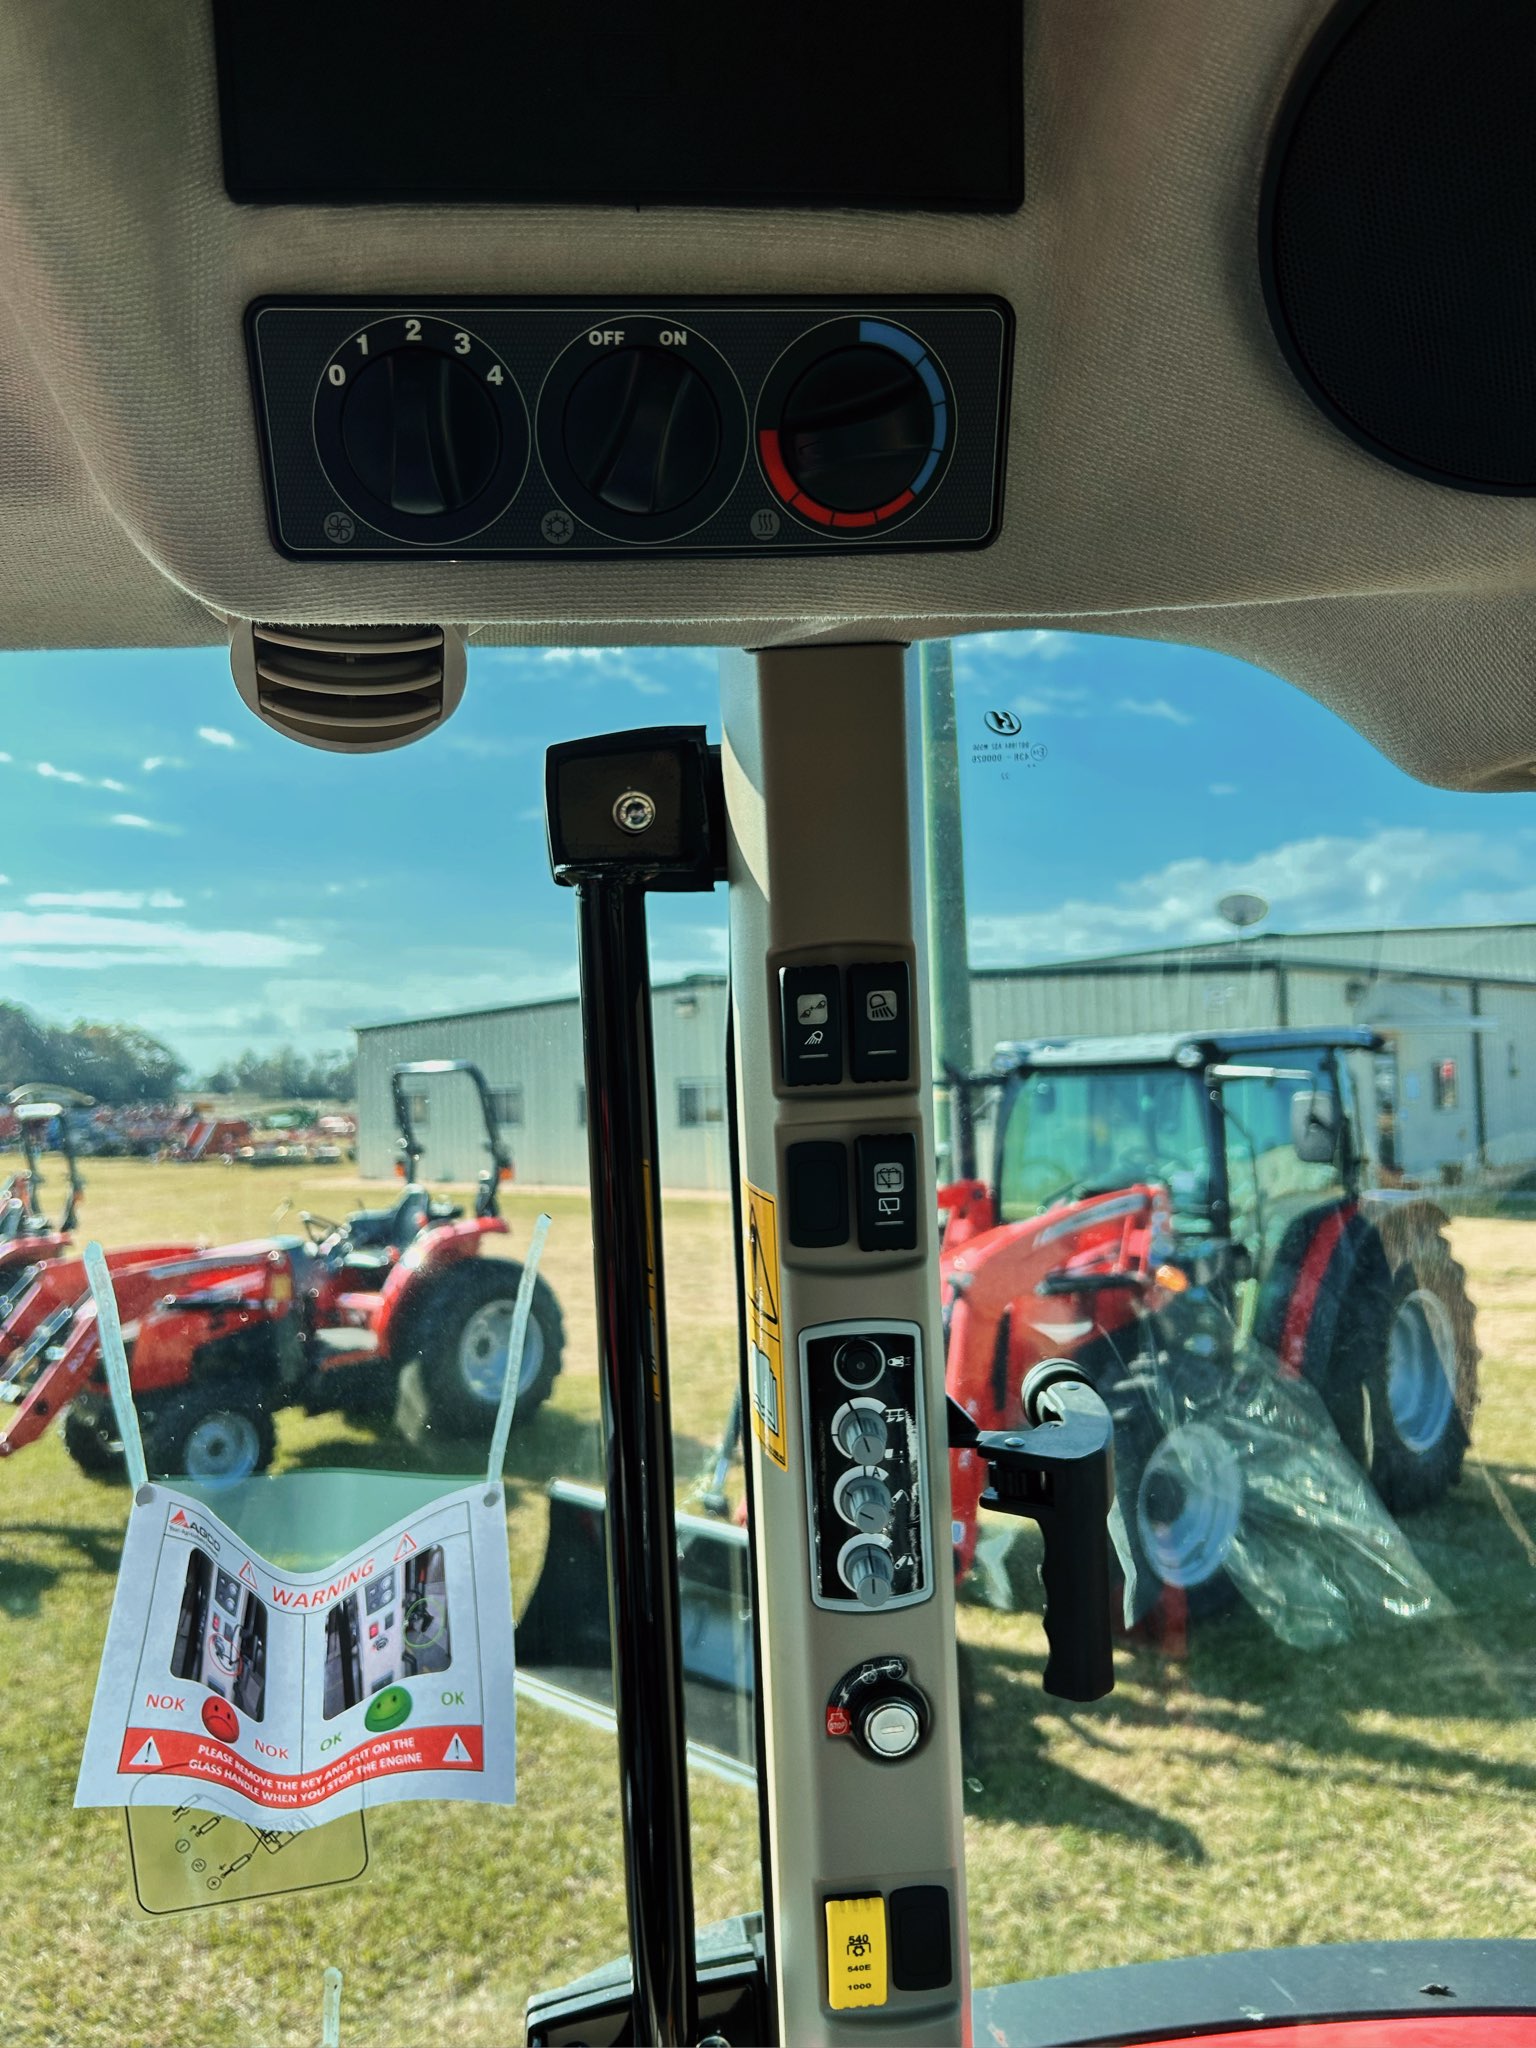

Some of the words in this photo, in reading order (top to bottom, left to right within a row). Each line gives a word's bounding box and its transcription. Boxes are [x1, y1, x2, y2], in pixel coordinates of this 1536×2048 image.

[588, 330, 625, 346] OFF
[659, 330, 688, 346] ON
[328, 364, 346, 386] 0
[356, 334, 369, 355] 1
[405, 319, 422, 341] 2
[454, 332, 471, 354] 3
[486, 365, 504, 386] 4
[871, 1466, 881, 1479] A
[190, 1521, 221, 1551] AGCO
[272, 1558, 375, 1608] WARNING
[146, 1693, 186, 1712] NOK
[441, 1691, 465, 1706] OK
[254, 1738, 289, 1760] NOK
[320, 1732, 342, 1752] OK
[198, 1744, 234, 1766] PLEASE
[234, 1760, 274, 1788] REMOVE
[275, 1780, 298, 1791] THE
[301, 1774, 323, 1790] KEY
[324, 1761, 348, 1781] AND
[349, 1748, 370, 1765] PUT
[372, 1740, 391, 1756] ON
[392, 1736, 415, 1750] THE
[188, 1758, 222, 1776] GLASS
[224, 1769, 260, 1798] HANDLE
[261, 1790, 298, 1803] WHEN
[300, 1785, 326, 1803] YOU
[327, 1770, 354, 1792] STOP
[356, 1760, 377, 1778] THE
[379, 1751, 423, 1769] ENGINE
[848, 1934, 869, 1946] 540
[847, 1963, 872, 1973] 540E
[848, 1982, 872, 1991] 1000
